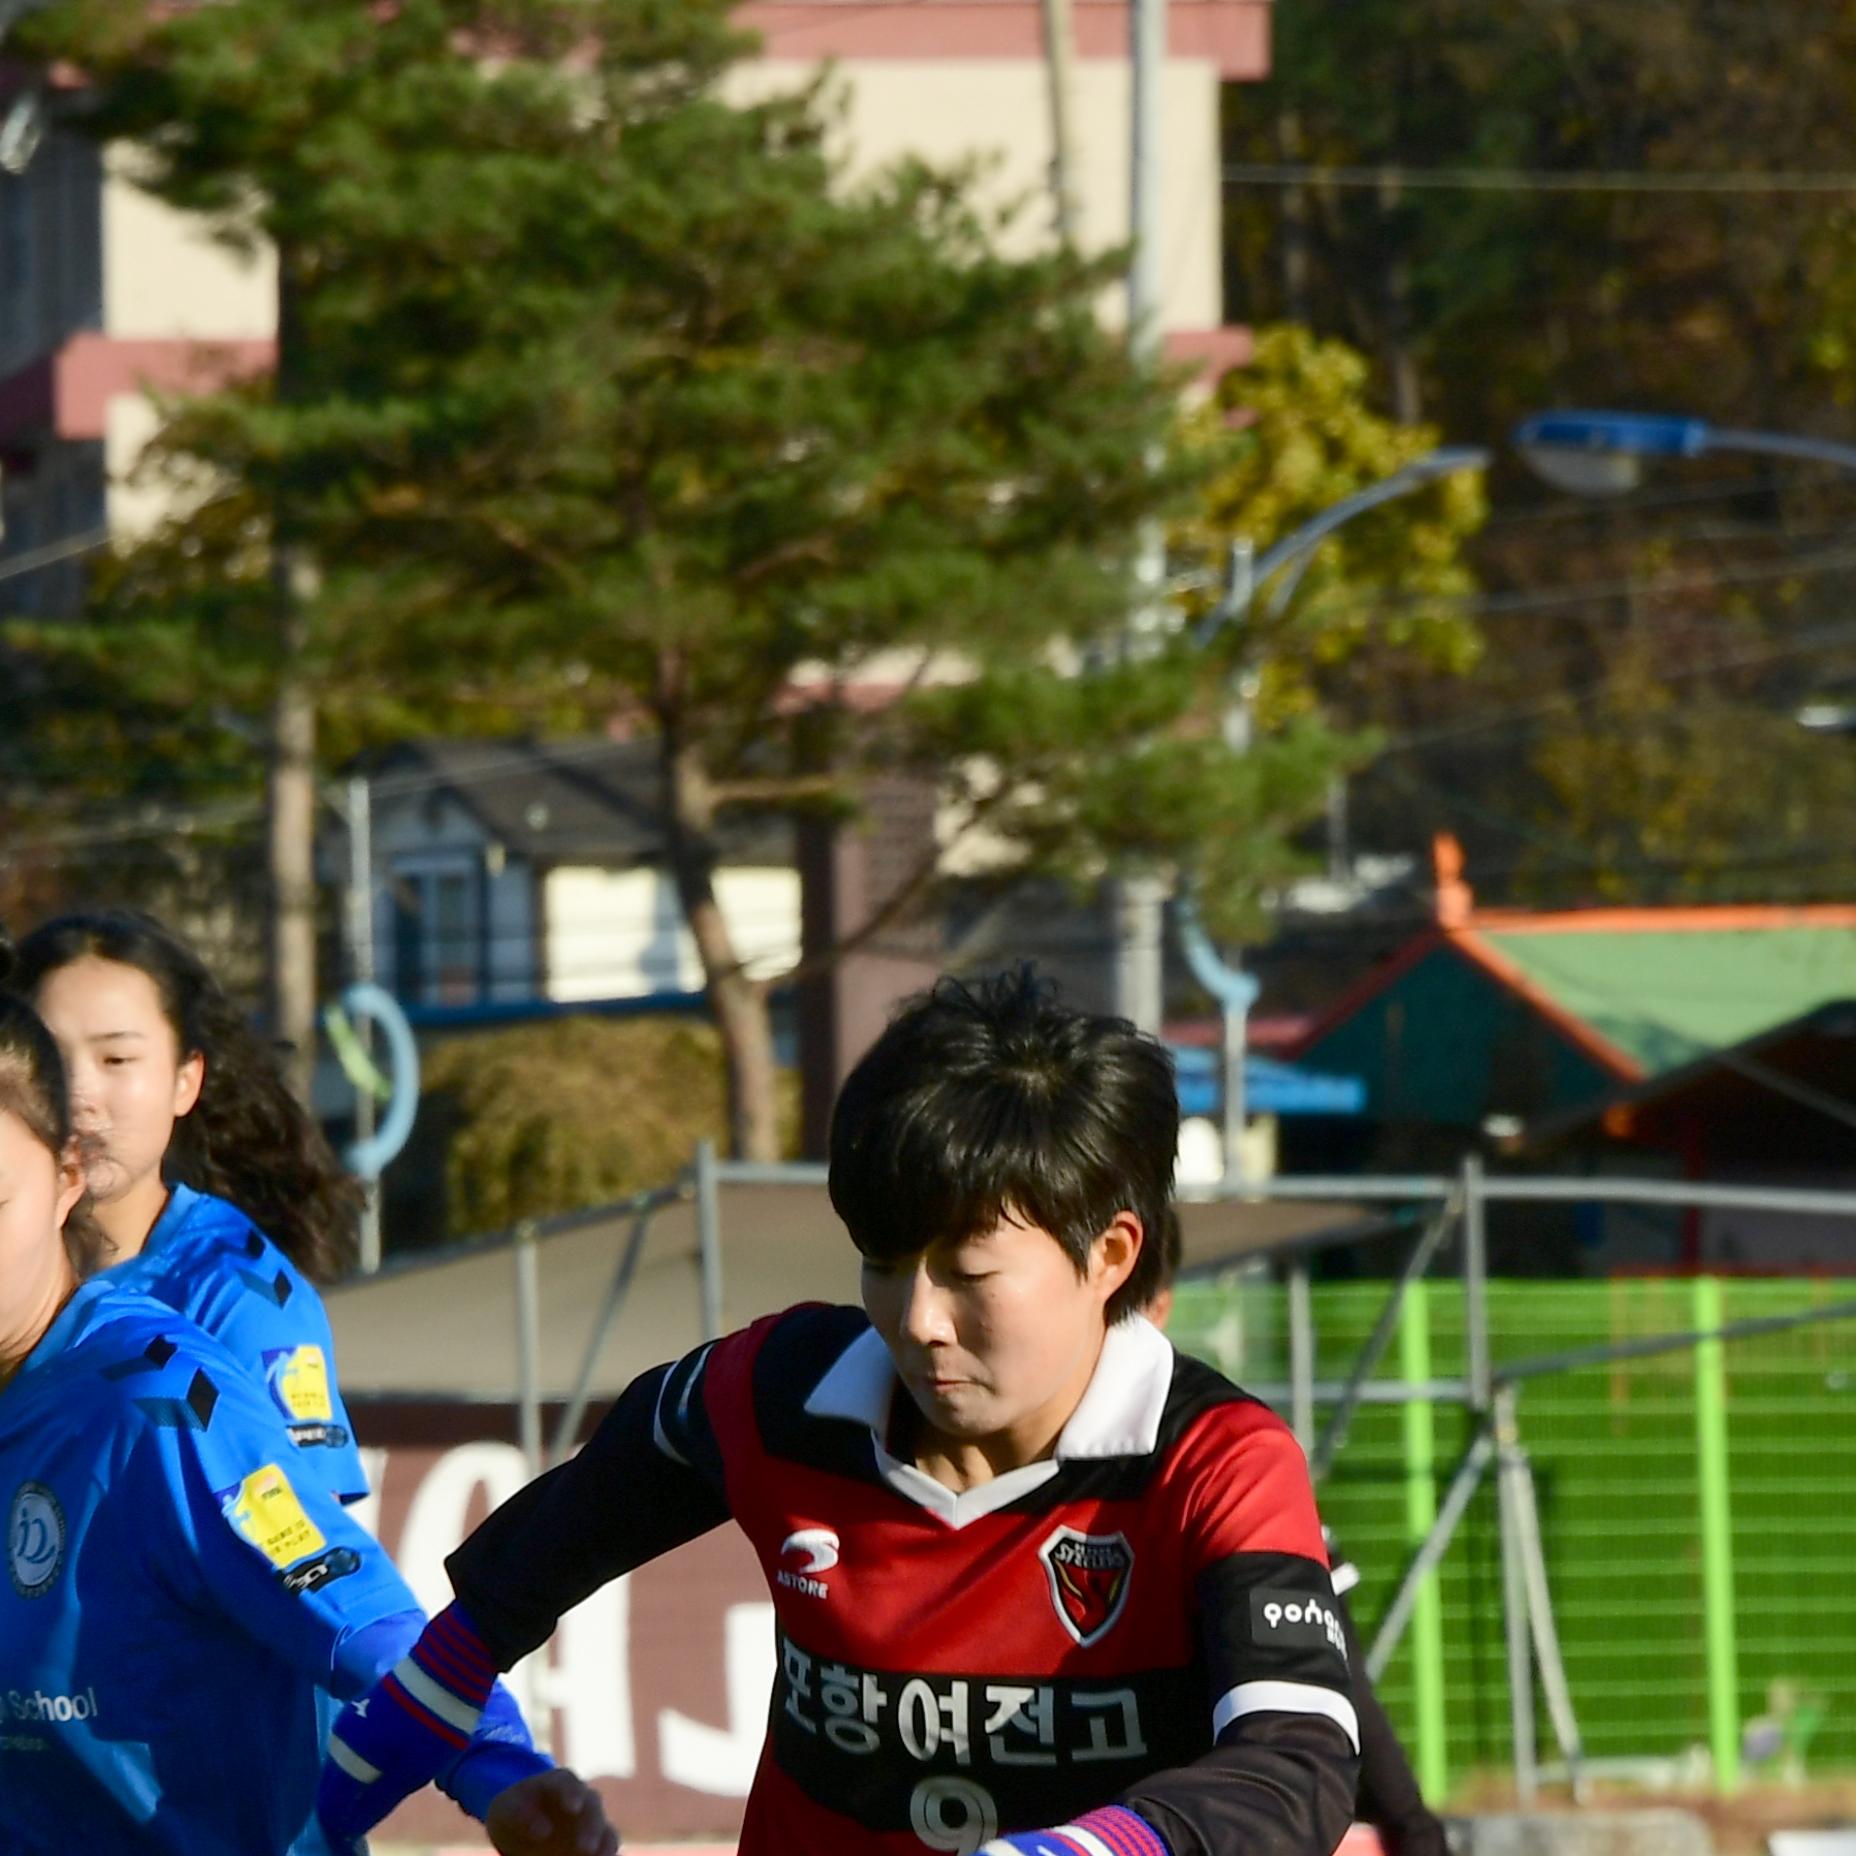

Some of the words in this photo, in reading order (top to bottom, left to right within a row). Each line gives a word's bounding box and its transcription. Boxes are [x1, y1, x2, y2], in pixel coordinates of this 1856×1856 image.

[777, 1568, 829, 1600] ASTORE
[8, 1686, 98, 1723] School
[782, 1636, 1149, 1768] 포항여전고
